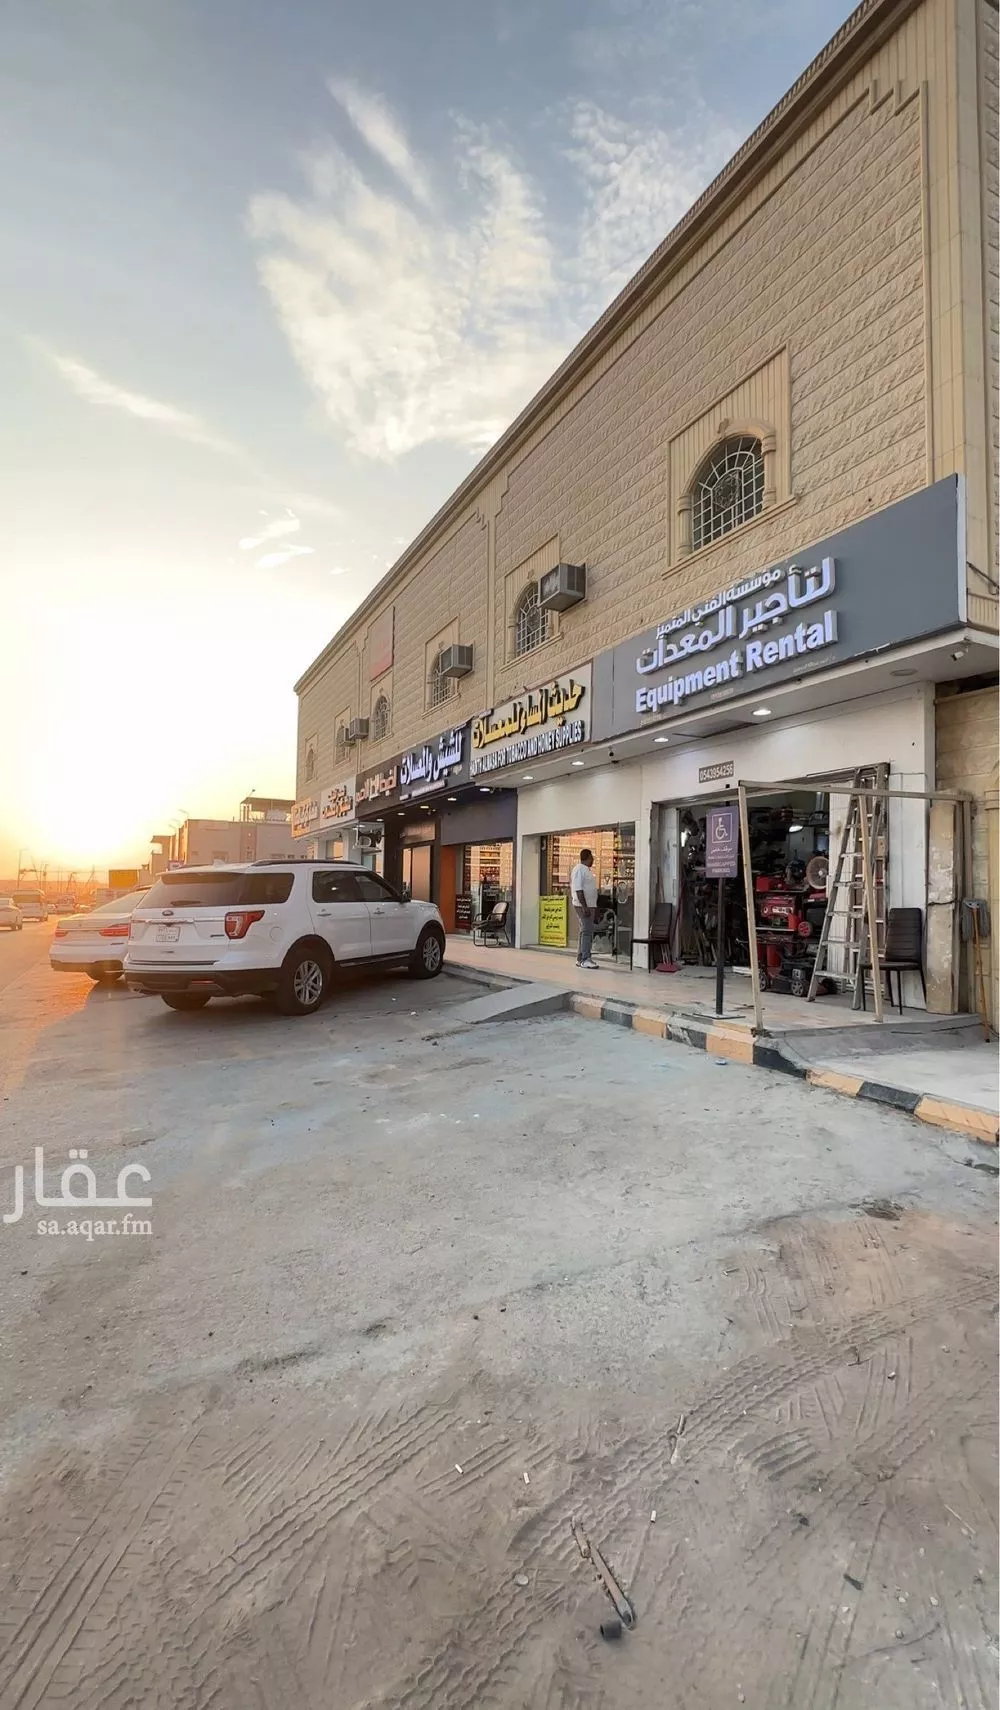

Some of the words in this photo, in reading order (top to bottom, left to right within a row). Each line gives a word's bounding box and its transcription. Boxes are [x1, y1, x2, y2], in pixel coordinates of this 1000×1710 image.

[692, 593, 727, 626] الفني
[726, 568, 782, 601] مؤسسة
[739, 556, 836, 639] لتأجير
[635, 650, 743, 713] Equipment
[746, 610, 838, 673] Rental
[636, 605, 737, 675] المعدات
[555, 720, 583, 749] SUPPLIES
